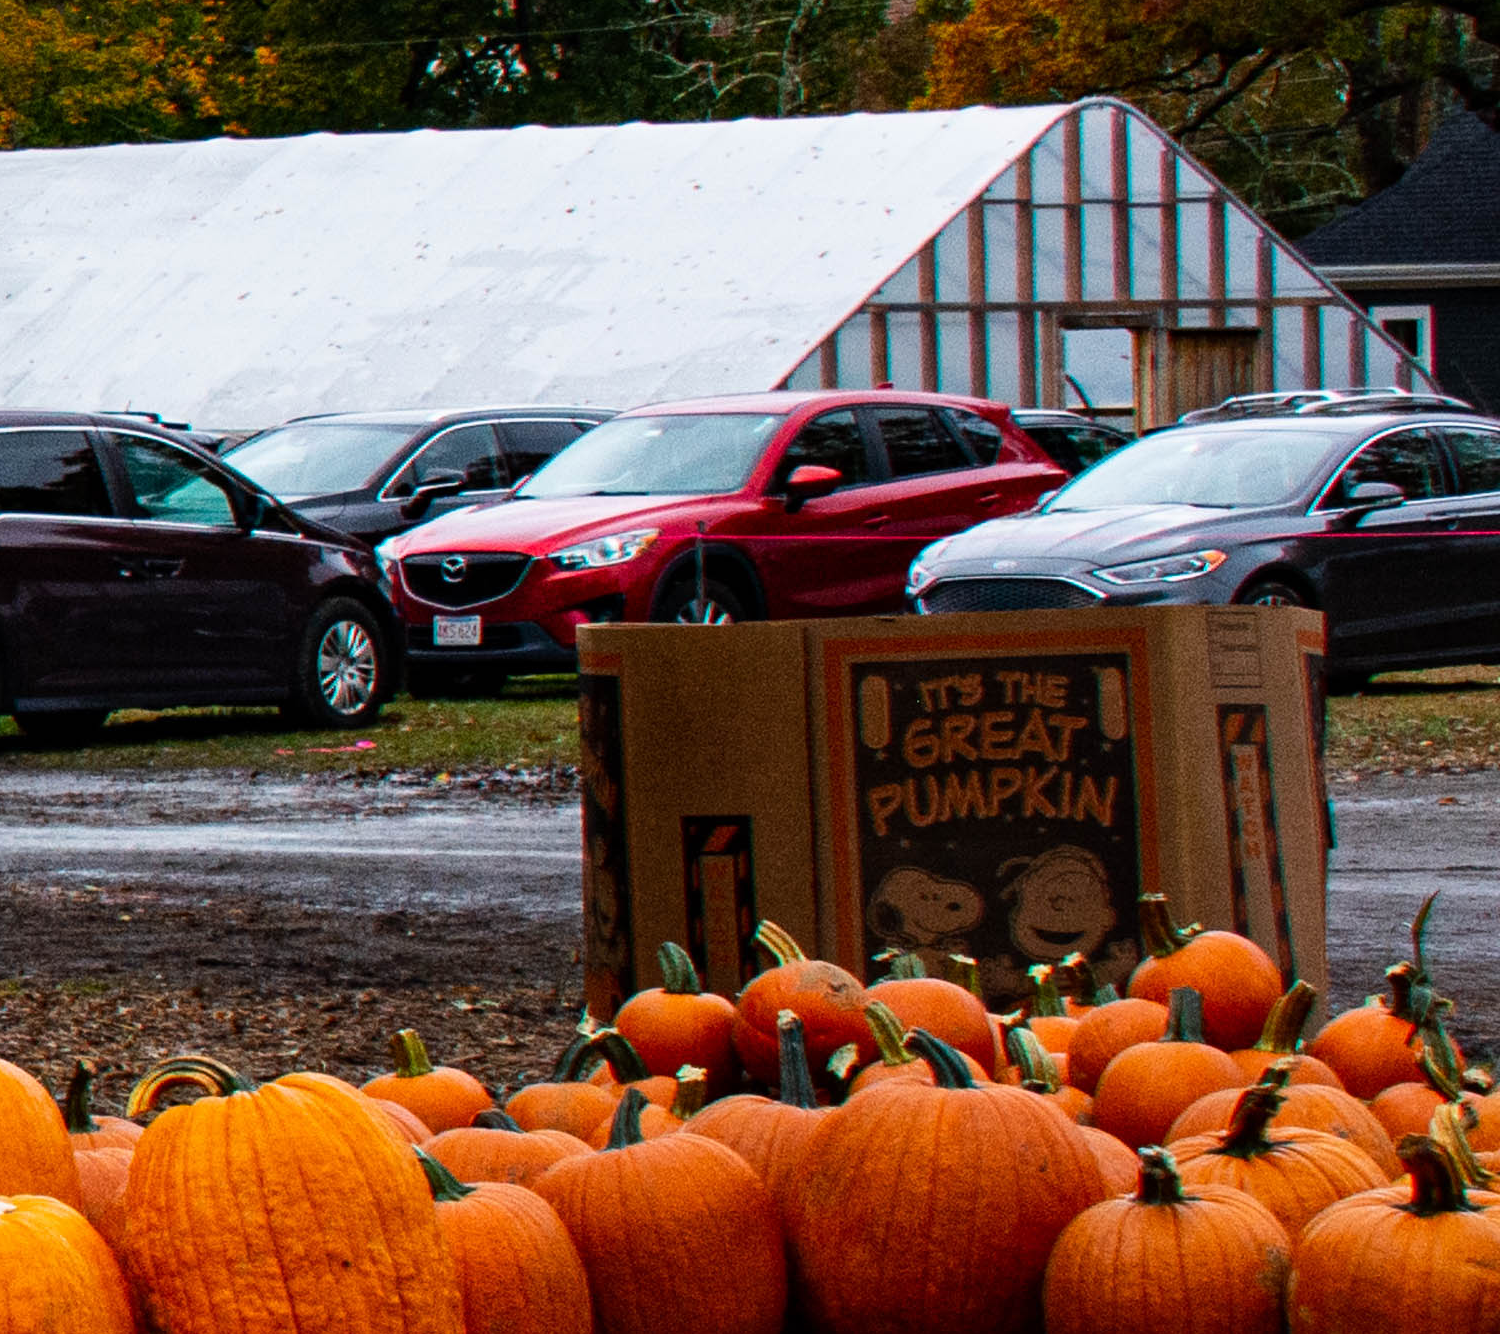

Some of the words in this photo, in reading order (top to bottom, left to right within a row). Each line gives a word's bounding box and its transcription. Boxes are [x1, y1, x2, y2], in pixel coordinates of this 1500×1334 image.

[998, 670, 1071, 708] THE
[902, 708, 1088, 769] GREAT
[869, 766, 1117, 837] PUMPKIN
